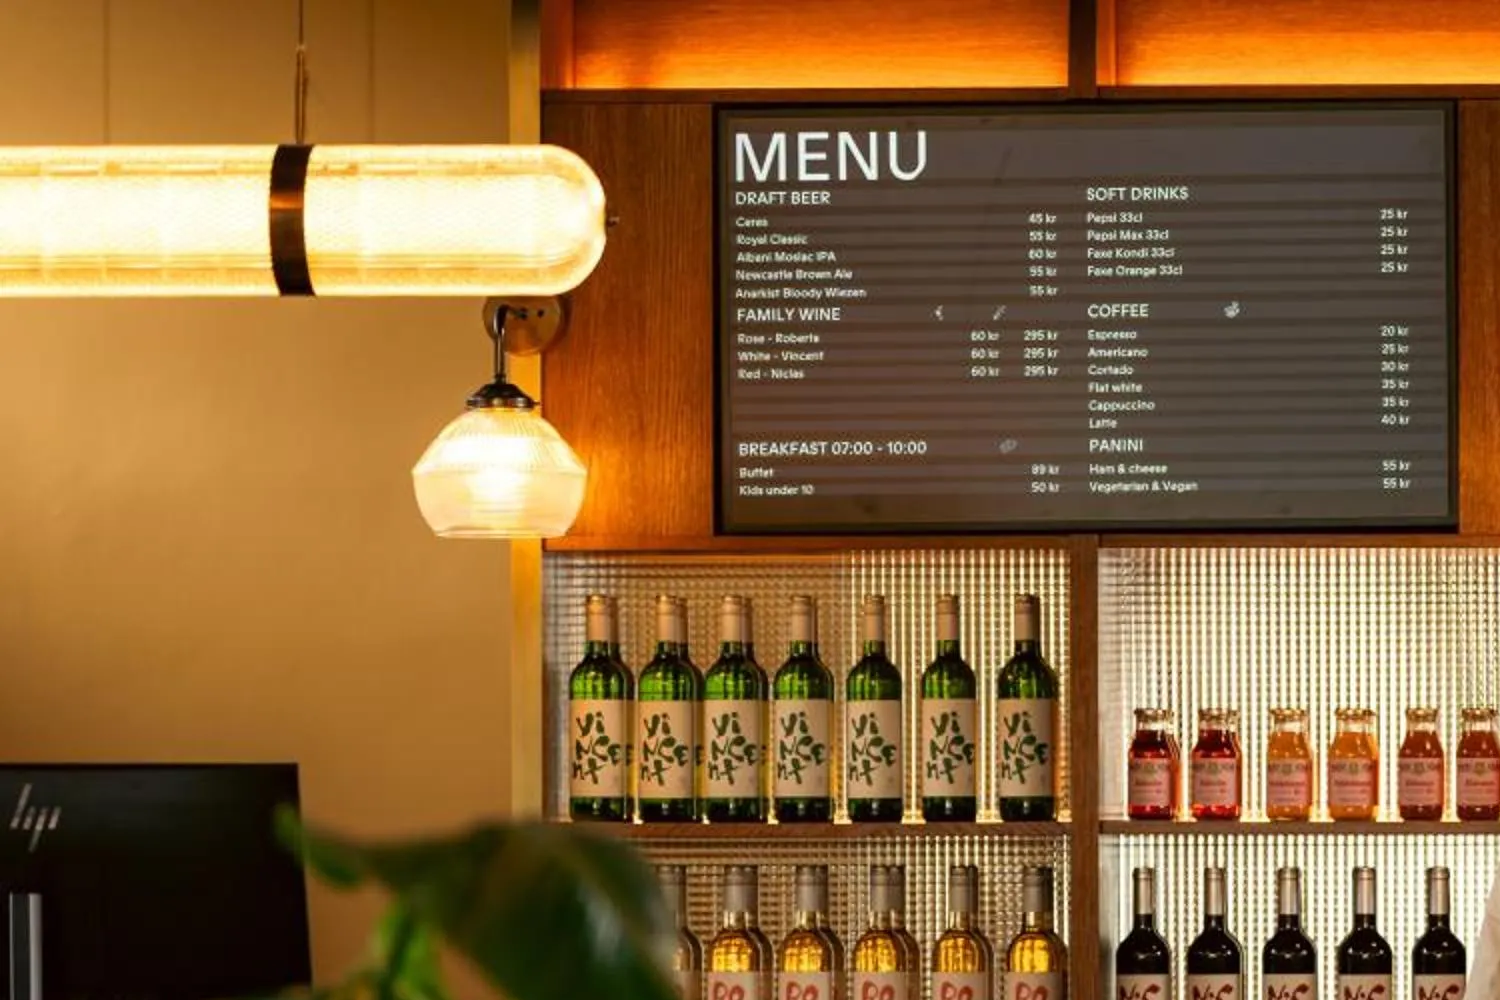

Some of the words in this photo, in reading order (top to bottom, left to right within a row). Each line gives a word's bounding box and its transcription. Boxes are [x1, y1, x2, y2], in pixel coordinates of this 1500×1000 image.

[736, 131, 927, 182] MENU
[736, 192, 787, 205] DRAFT
[790, 191, 831, 204] BEER
[1087, 187, 1127, 201] SOFT
[1131, 186, 1189, 200] DRINKS
[736, 216, 769, 227] Ceres
[1087, 212, 1117, 224] Pepsi
[1380, 208, 1395, 219] 25
[1397, 208, 1408, 219] kr
[736, 234, 768, 246] Royal
[770, 234, 808, 245] Classic
[1087, 230, 1117, 242] Pepsi
[1119, 230, 1144, 241] Max
[1380, 226, 1395, 237] 25
[1397, 226, 1408, 237] kr
[737, 251, 772, 262] Albani
[816, 251, 837, 262] IPA
[1087, 247, 1113, 258] Faxe
[1115, 247, 1149, 258] Kondi
[1380, 244, 1395, 255] 25
[1397, 244, 1408, 255] kr
[736, 269, 793, 280] Newcastle
[795, 268, 832, 280] Brown
[834, 268, 853, 279] Ale
[1087, 265, 1113, 276] Faxe
[1115, 265, 1157, 278] Orange
[1380, 261, 1395, 272] 25
[1397, 261, 1408, 272] kr
[735, 287, 781, 299] Anarkist
[783, 287, 823, 299] Bloody
[738, 308, 795, 321] FAMILY
[798, 308, 841, 321] WINE
[1087, 304, 1149, 318] COFFEE
[737, 333, 765, 344] Rose
[988, 331, 999, 341] kr
[1047, 330, 1058, 341] kr
[1087, 329, 1137, 341] Espresso
[1381, 326, 1395, 337] 20
[737, 351, 771, 362] White
[781, 350, 825, 362] Vincent
[988, 348, 999, 359] kr
[1047, 348, 1058, 359] kr
[1087, 347, 1149, 358] Americano
[1381, 343, 1396, 354] 25
[1398, 343, 1409, 354] kr
[737, 369, 760, 379] Red
[971, 365, 986, 376] 60
[988, 365, 999, 376] kr
[1024, 365, 1045, 376] 295
[1047, 365, 1058, 376] kr
[1087, 364, 1134, 375] Cortado
[1398, 361, 1409, 372] kr
[1088, 382, 1109, 393] Flat
[1111, 382, 1143, 393] white
[1398, 379, 1409, 389] kr
[1088, 400, 1156, 412] Cappuccino
[1398, 396, 1409, 407] kr
[1088, 417, 1118, 428] Latte
[1381, 414, 1396, 425] 40
[1398, 414, 1409, 425] kr
[739, 442, 828, 456] BREAKFAST
[831, 441, 873, 455] 07:00
[887, 440, 928, 454] 10:00
[1089, 439, 1143, 452] PANINI
[739, 467, 774, 478] Buffet
[1048, 463, 1060, 474] kr
[1089, 463, 1115, 475] Ham
[1128, 463, 1168, 475] cheese
[1399, 460, 1411, 471] kr
[739, 485, 763, 496] Kids
[765, 485, 799, 496] under
[801, 484, 814, 495] 10
[1048, 481, 1060, 492] kr
[1089, 481, 1149, 494] Vegetarian
[1162, 481, 1198, 493] Vegan
[1399, 477, 1411, 488] kr
[10, 783, 61, 852] hp
